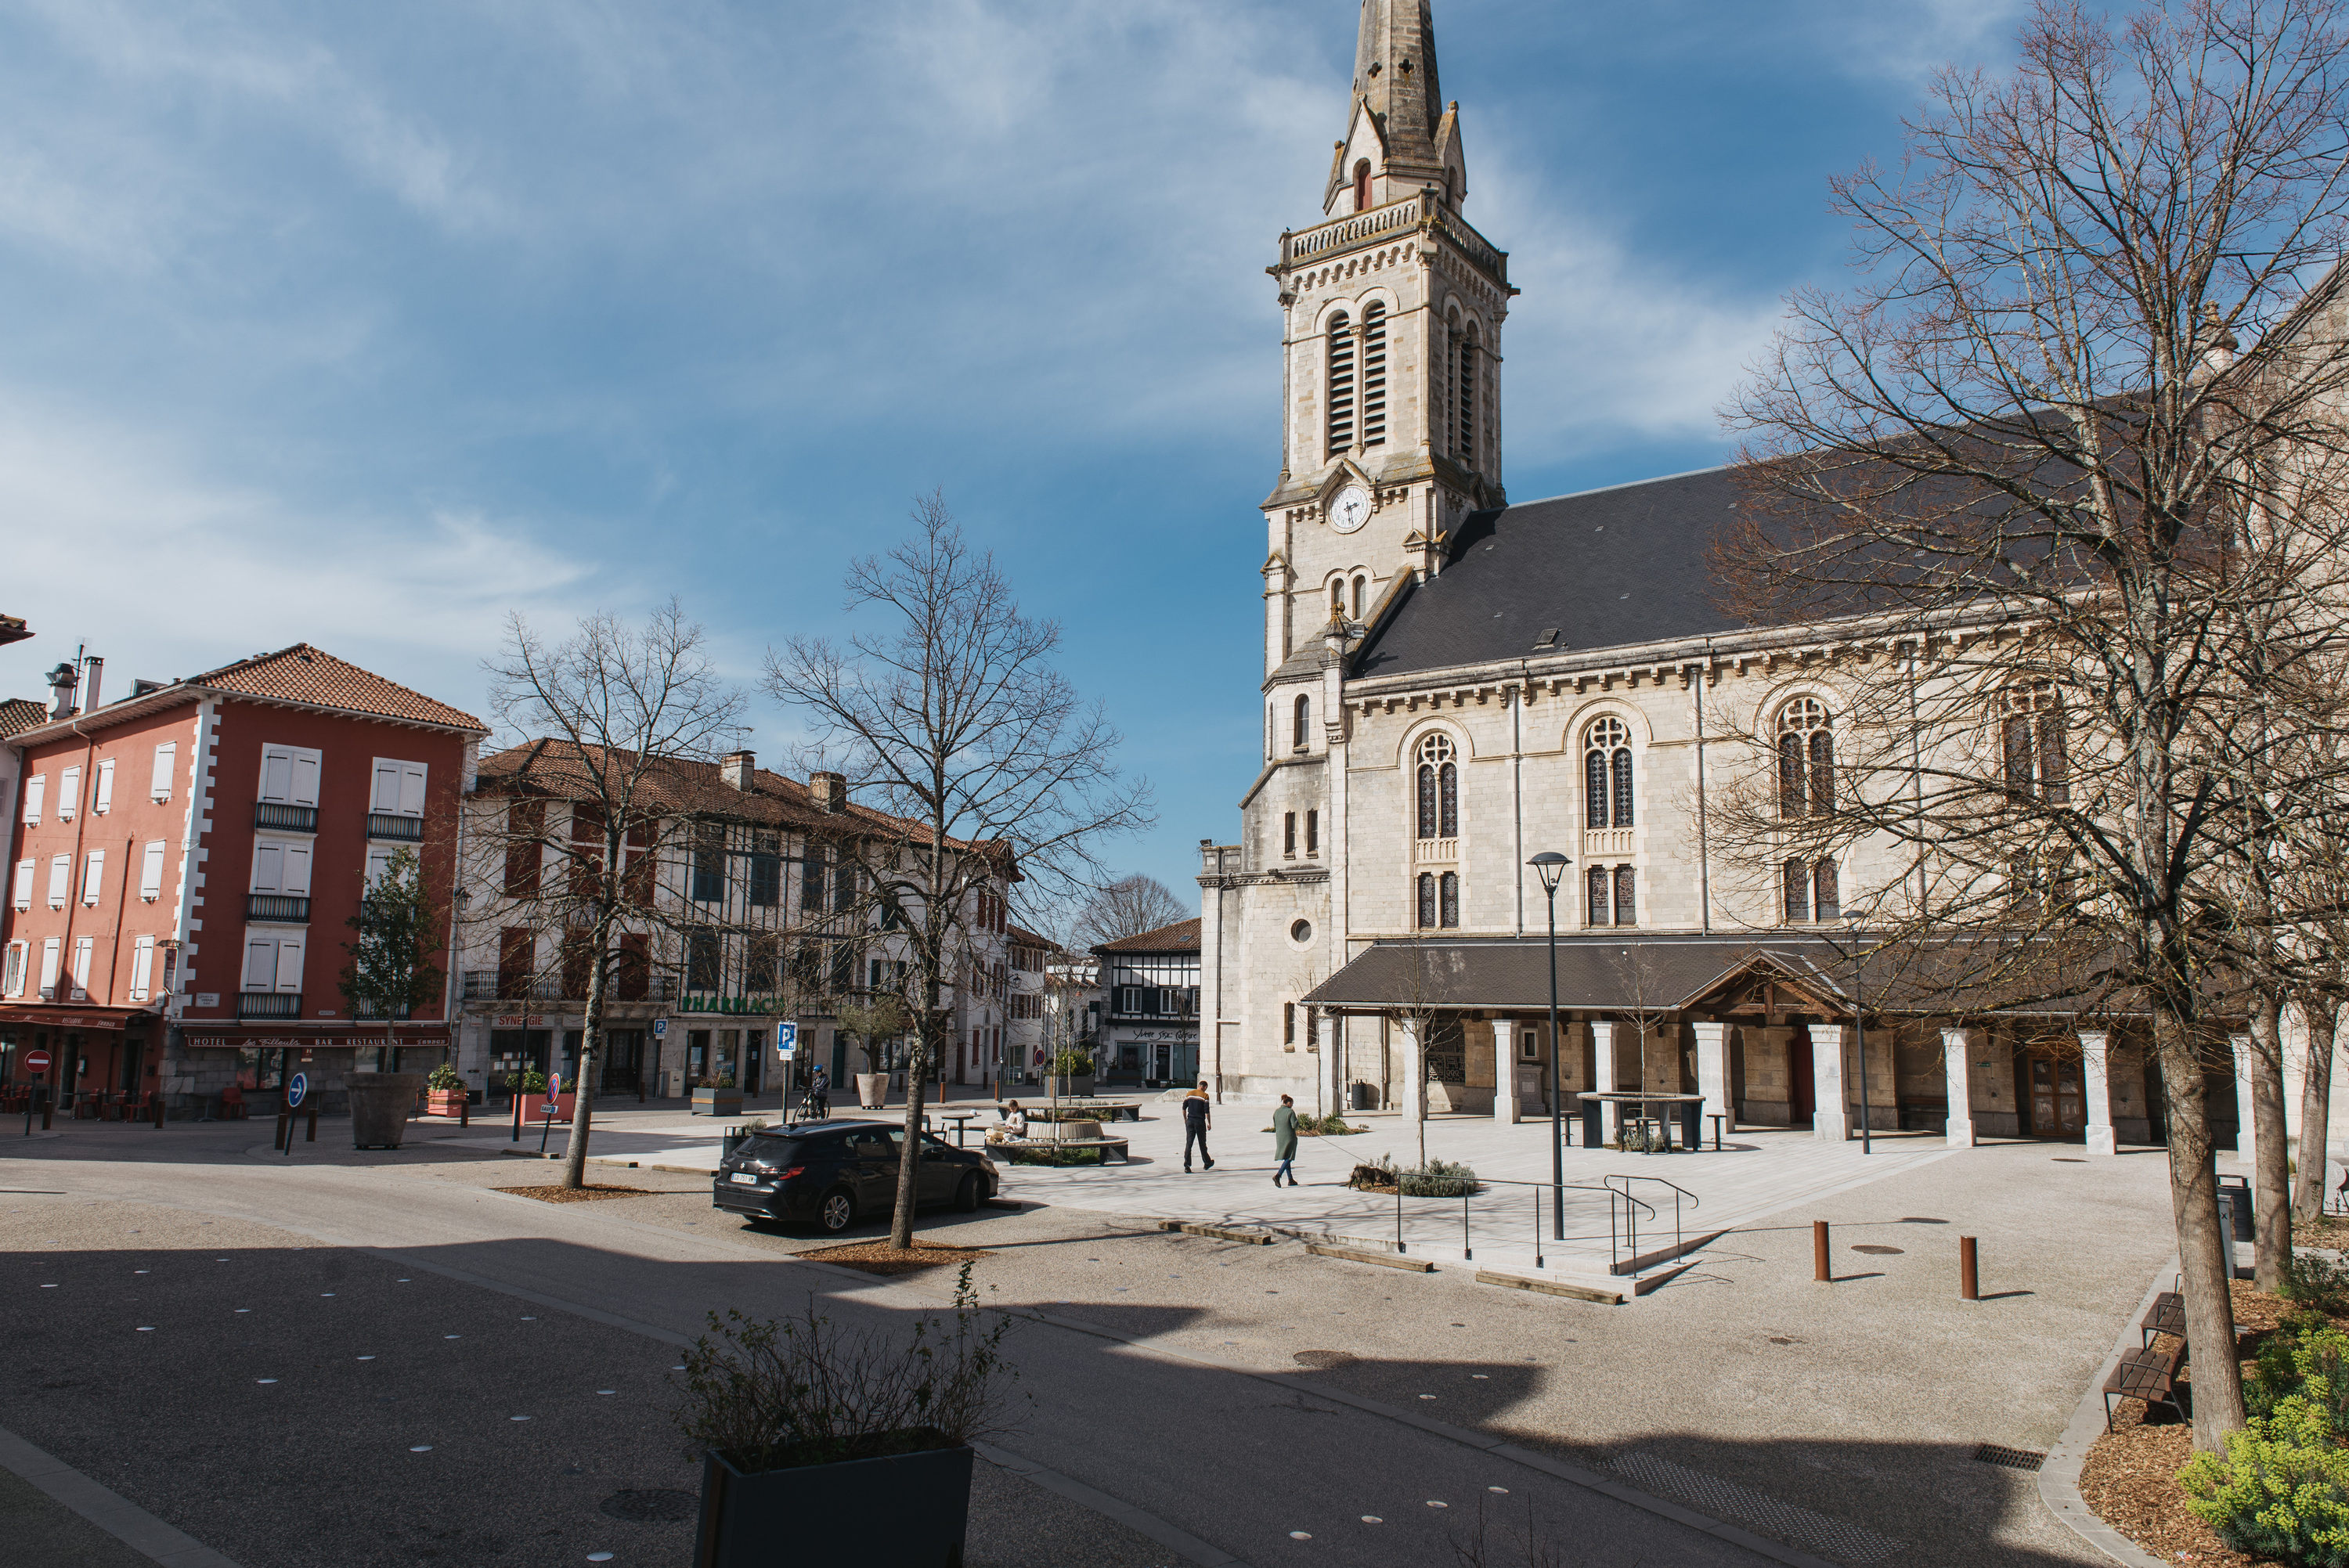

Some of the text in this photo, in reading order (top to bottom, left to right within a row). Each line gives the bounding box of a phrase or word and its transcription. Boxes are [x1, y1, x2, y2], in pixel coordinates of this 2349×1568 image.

[499, 1015, 543, 1026] SYNEGIE
[657, 1022, 664, 1032] P
[781, 1028, 791, 1046] P
